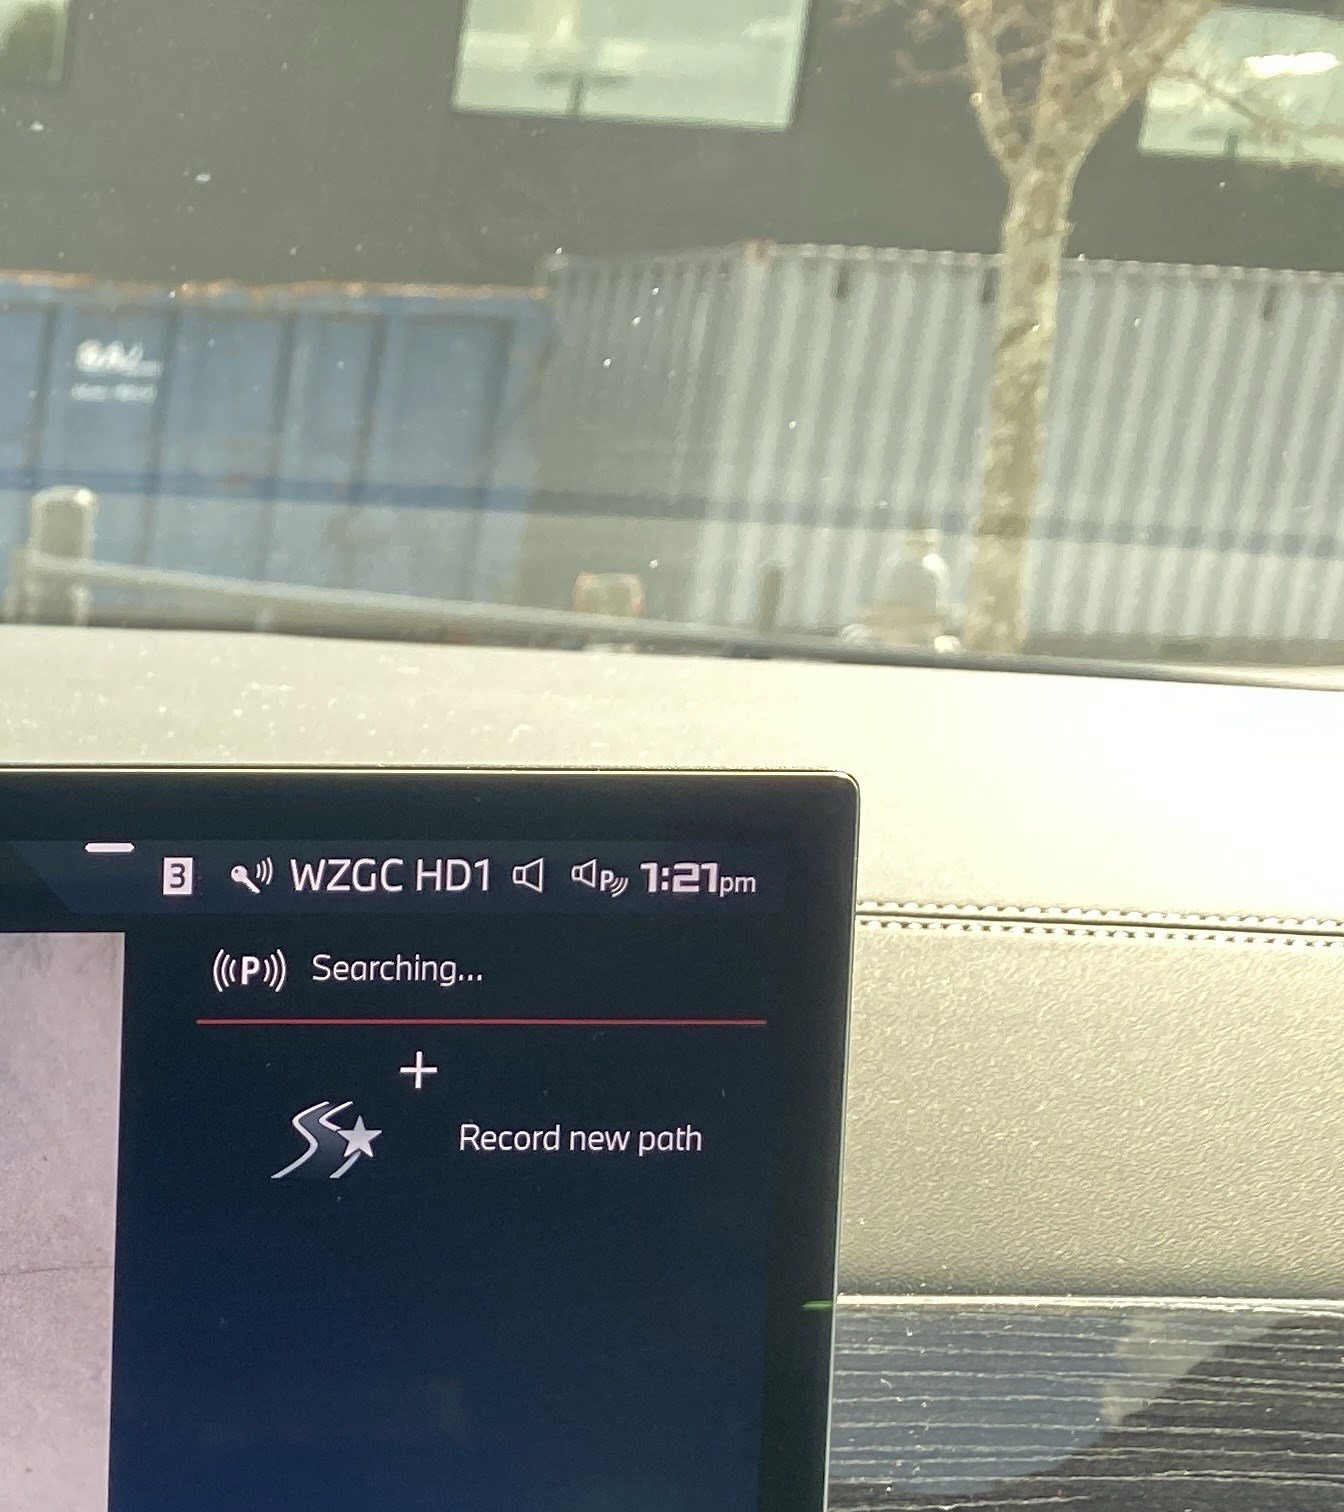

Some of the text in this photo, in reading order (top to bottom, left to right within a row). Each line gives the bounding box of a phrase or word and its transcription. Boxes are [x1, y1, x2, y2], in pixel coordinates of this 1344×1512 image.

[168, 863, 189, 890] 3
[289, 857, 491, 893] WZGC HD1
[311, 952, 484, 988] Searching...
[458, 1122, 703, 1158] Record new path
